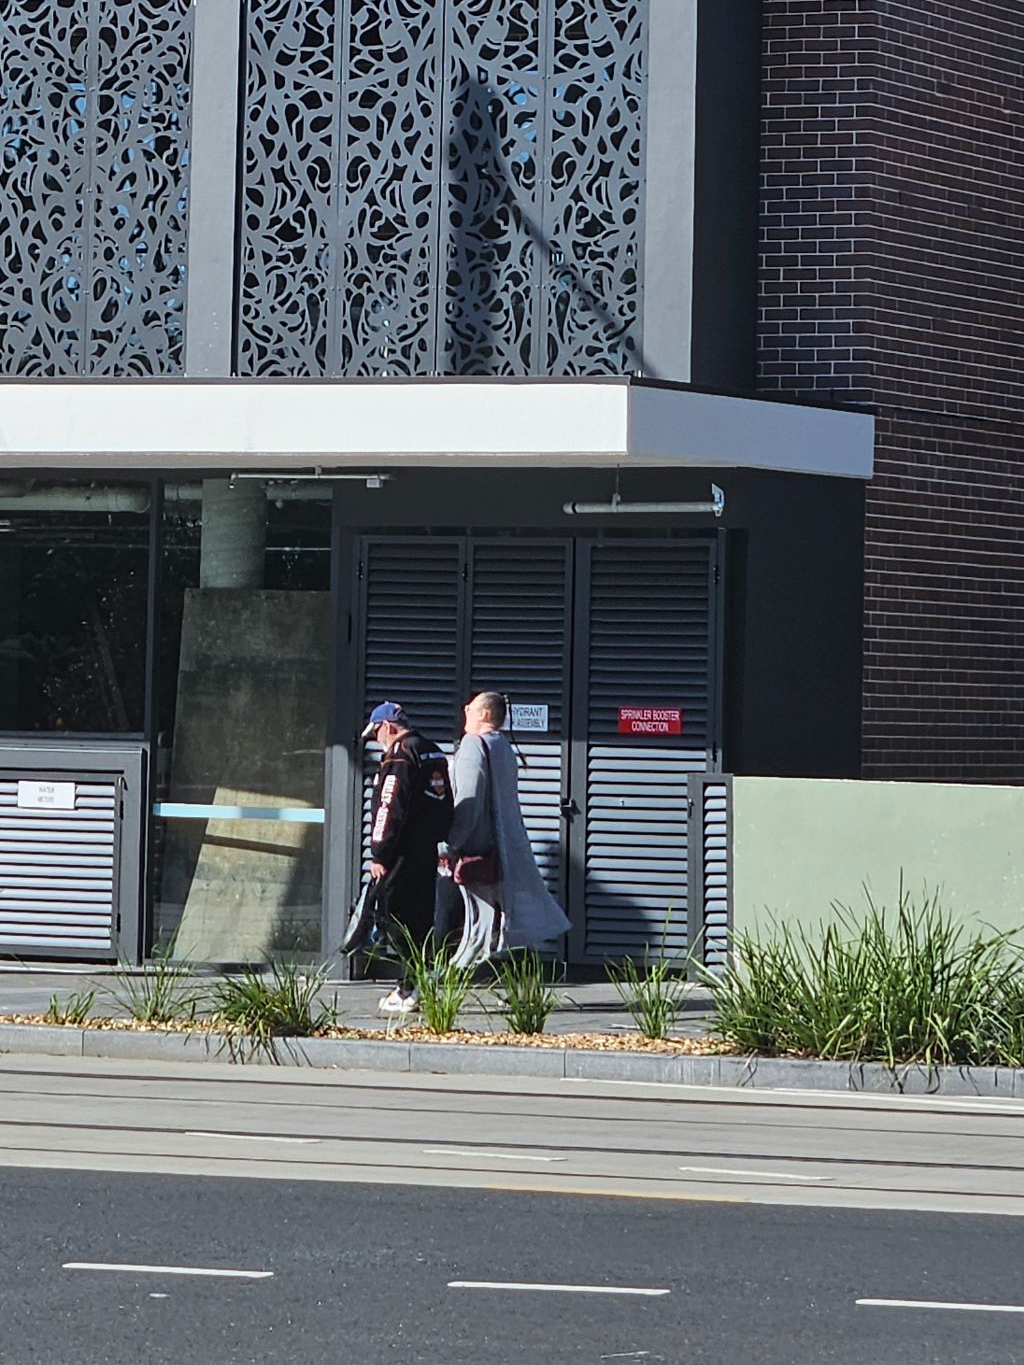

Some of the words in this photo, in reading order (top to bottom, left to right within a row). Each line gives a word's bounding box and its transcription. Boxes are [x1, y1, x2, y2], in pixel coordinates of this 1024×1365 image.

[620, 709, 652, 720] SPRINKLER
[653, 710, 680, 721] BOOSTER
[631, 721, 669, 732] CONNECTION
